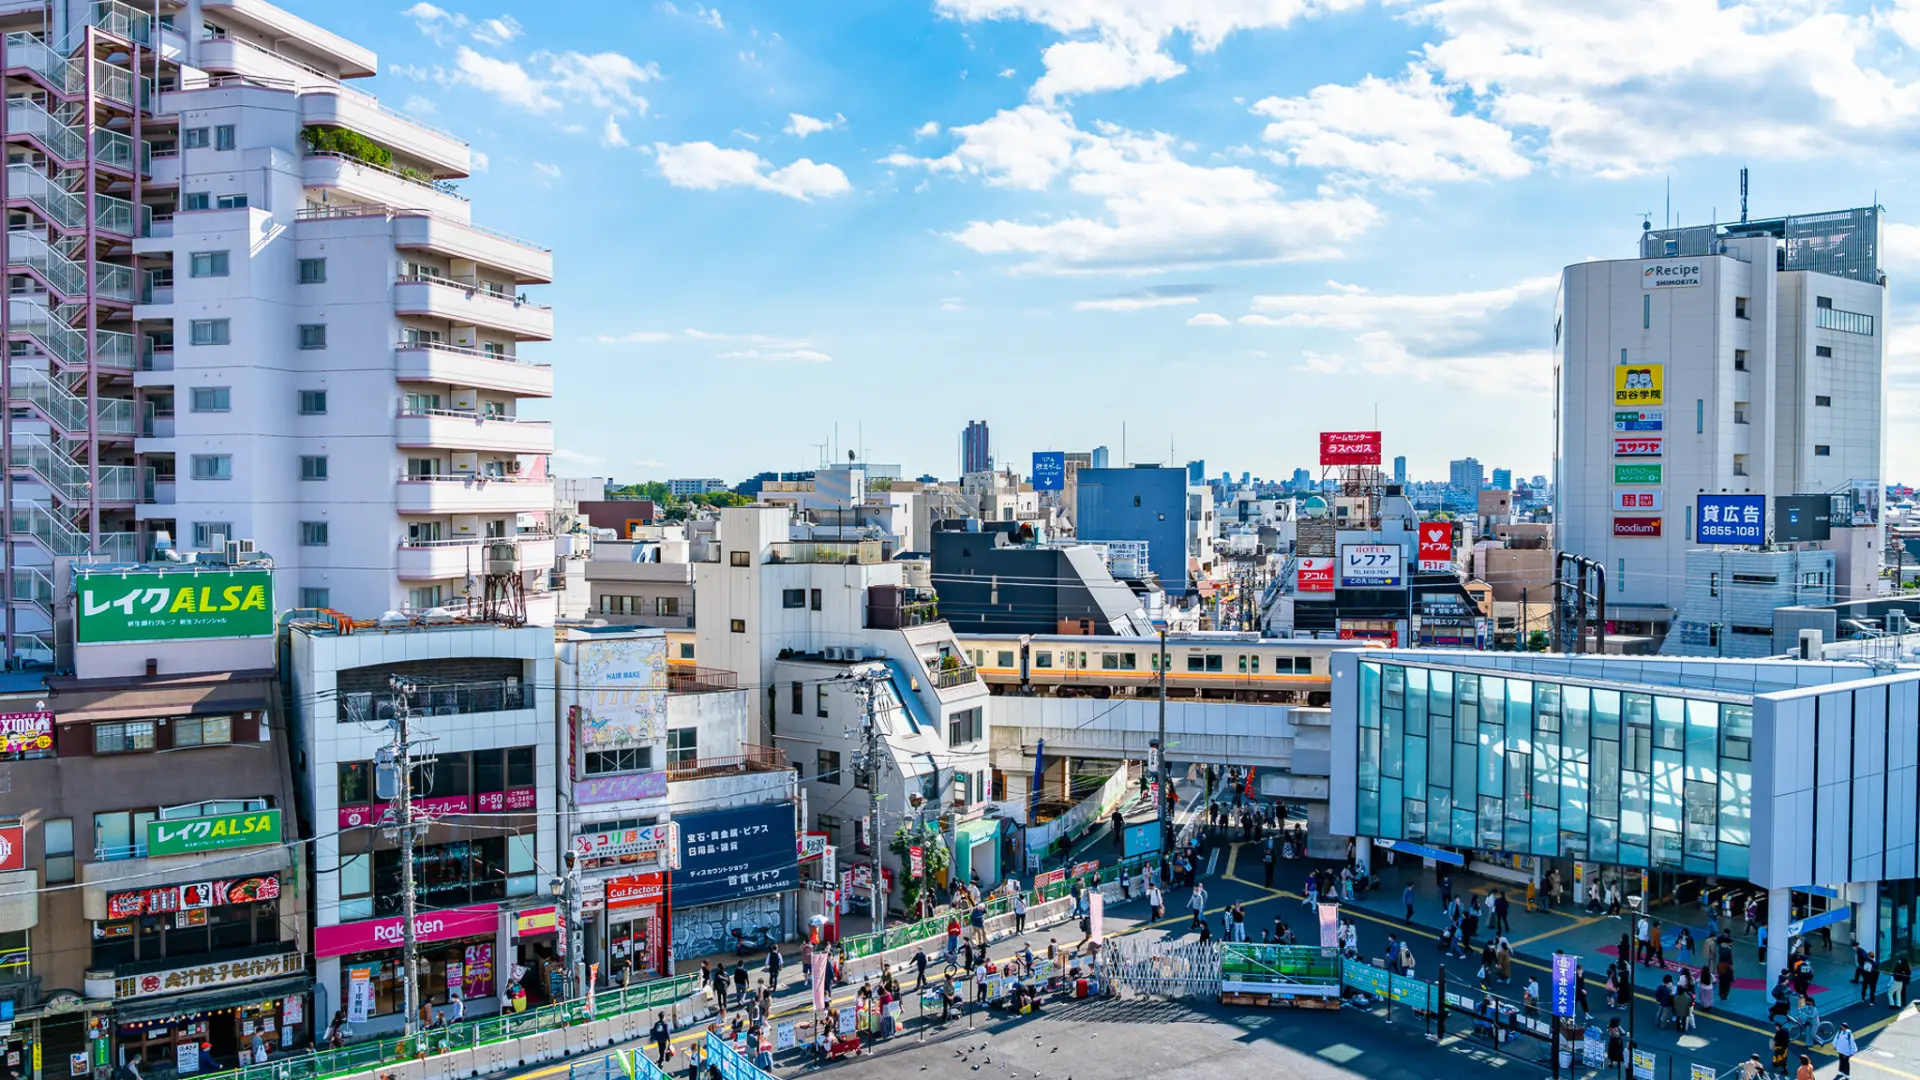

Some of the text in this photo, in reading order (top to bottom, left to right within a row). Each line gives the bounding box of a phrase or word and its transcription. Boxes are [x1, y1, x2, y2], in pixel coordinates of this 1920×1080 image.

[1656, 265, 1699, 278] Recipe
[1616, 390, 1661, 400] 四谷学院
[1330, 434, 1372, 442] ゲームセンター
[1329, 444, 1373, 453] ラスベガス
[1703, 505, 1760, 524] 貸広告
[1616, 522, 1655, 533] foodium
[1702, 526, 1760, 537] 3855-1081
[1421, 543, 1450, 552] アイフル
[1350, 555, 1393, 566] レフア
[84, 586, 266, 616] レイクALSA
[606, 670, 641, 680] HAIR MAKE
[479, 794, 503, 804] 8-50
[158, 815, 271, 843] レイクALSA
[687, 824, 769, 843] 宝石・貴金属・ピアス
[597, 828, 665, 846] コリほぐし
[688, 841, 738, 857] 日用品・雑貨
[690, 863, 748, 878] ディスカウントショップ
[727, 869, 780, 886] 百貨イトウ
[610, 884, 661, 898] Cut Factory
[374, 919, 443, 941] Rakten
